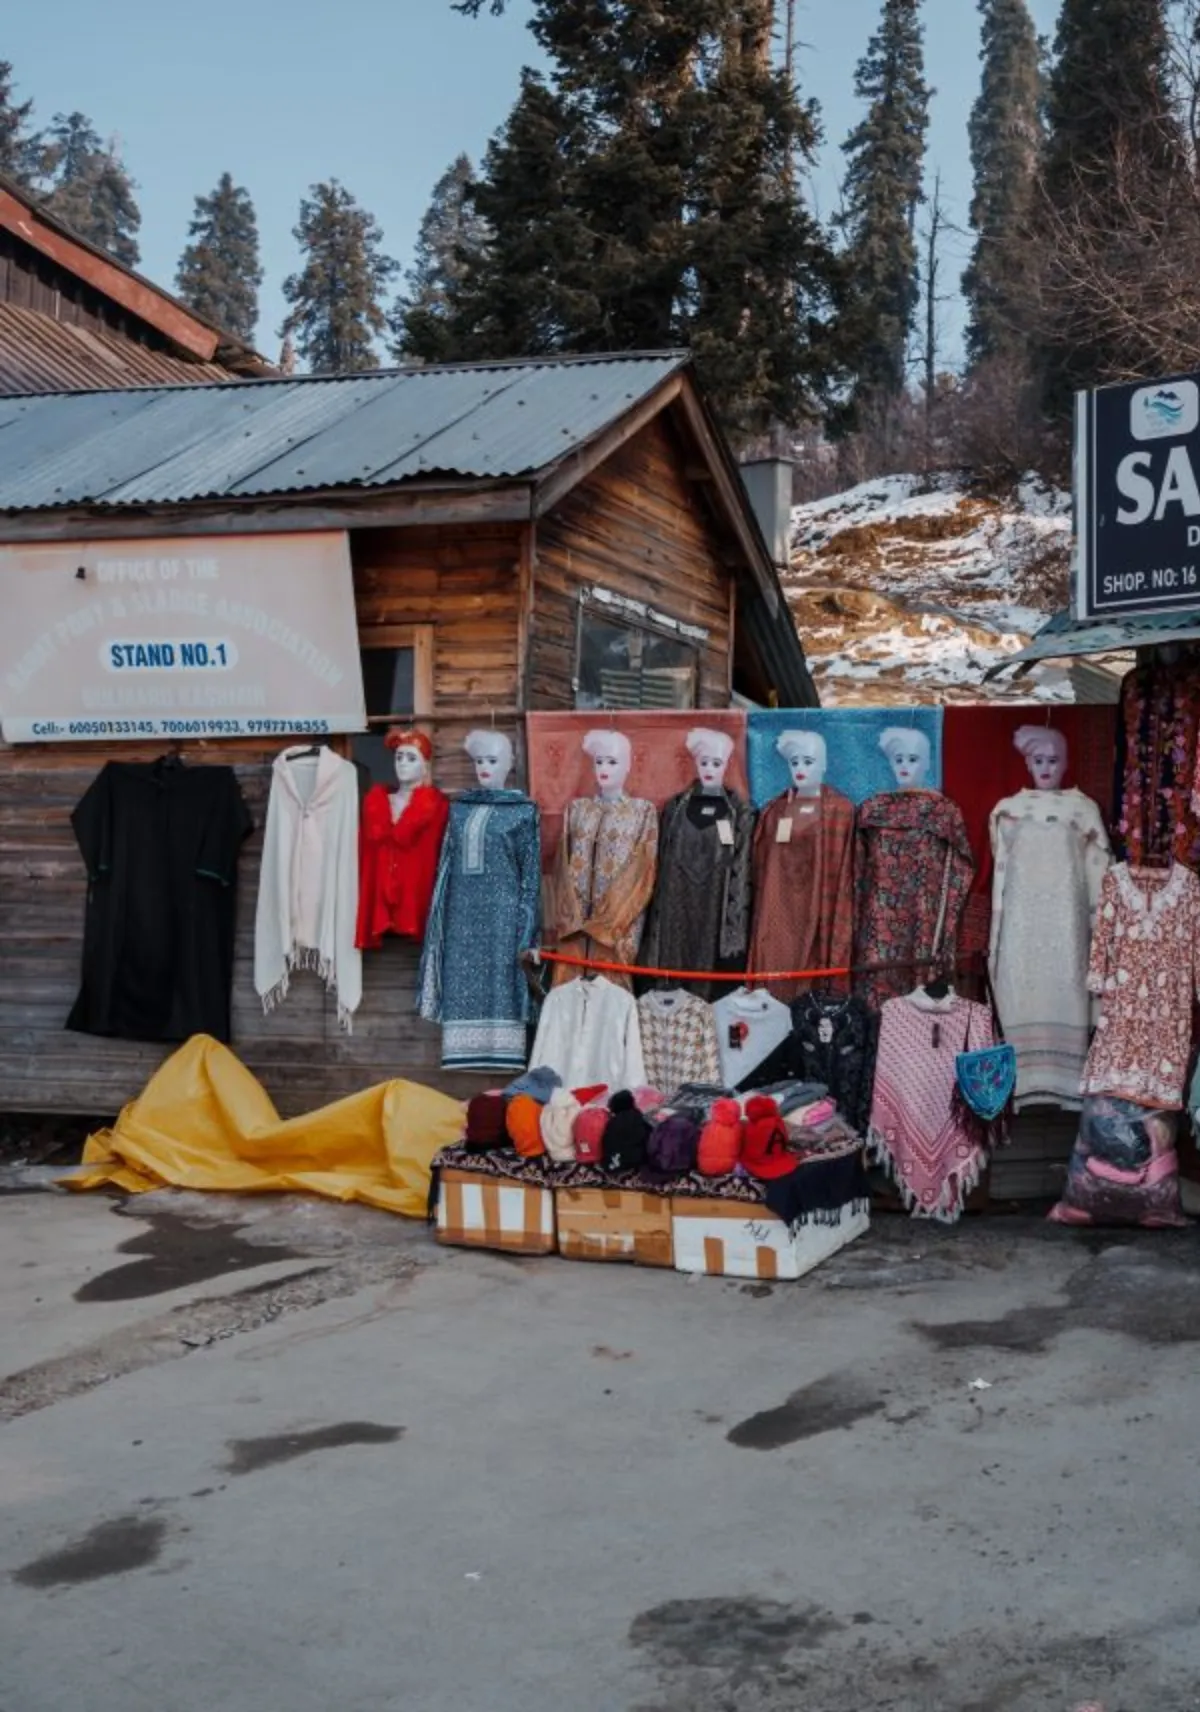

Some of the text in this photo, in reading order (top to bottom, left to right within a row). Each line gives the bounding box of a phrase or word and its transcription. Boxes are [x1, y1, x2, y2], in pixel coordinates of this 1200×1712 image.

[97, 558, 220, 583] OFFICE OF THE
[1181, 565, 1197, 585] 16
[111, 643, 228, 668] STAND NO.1
